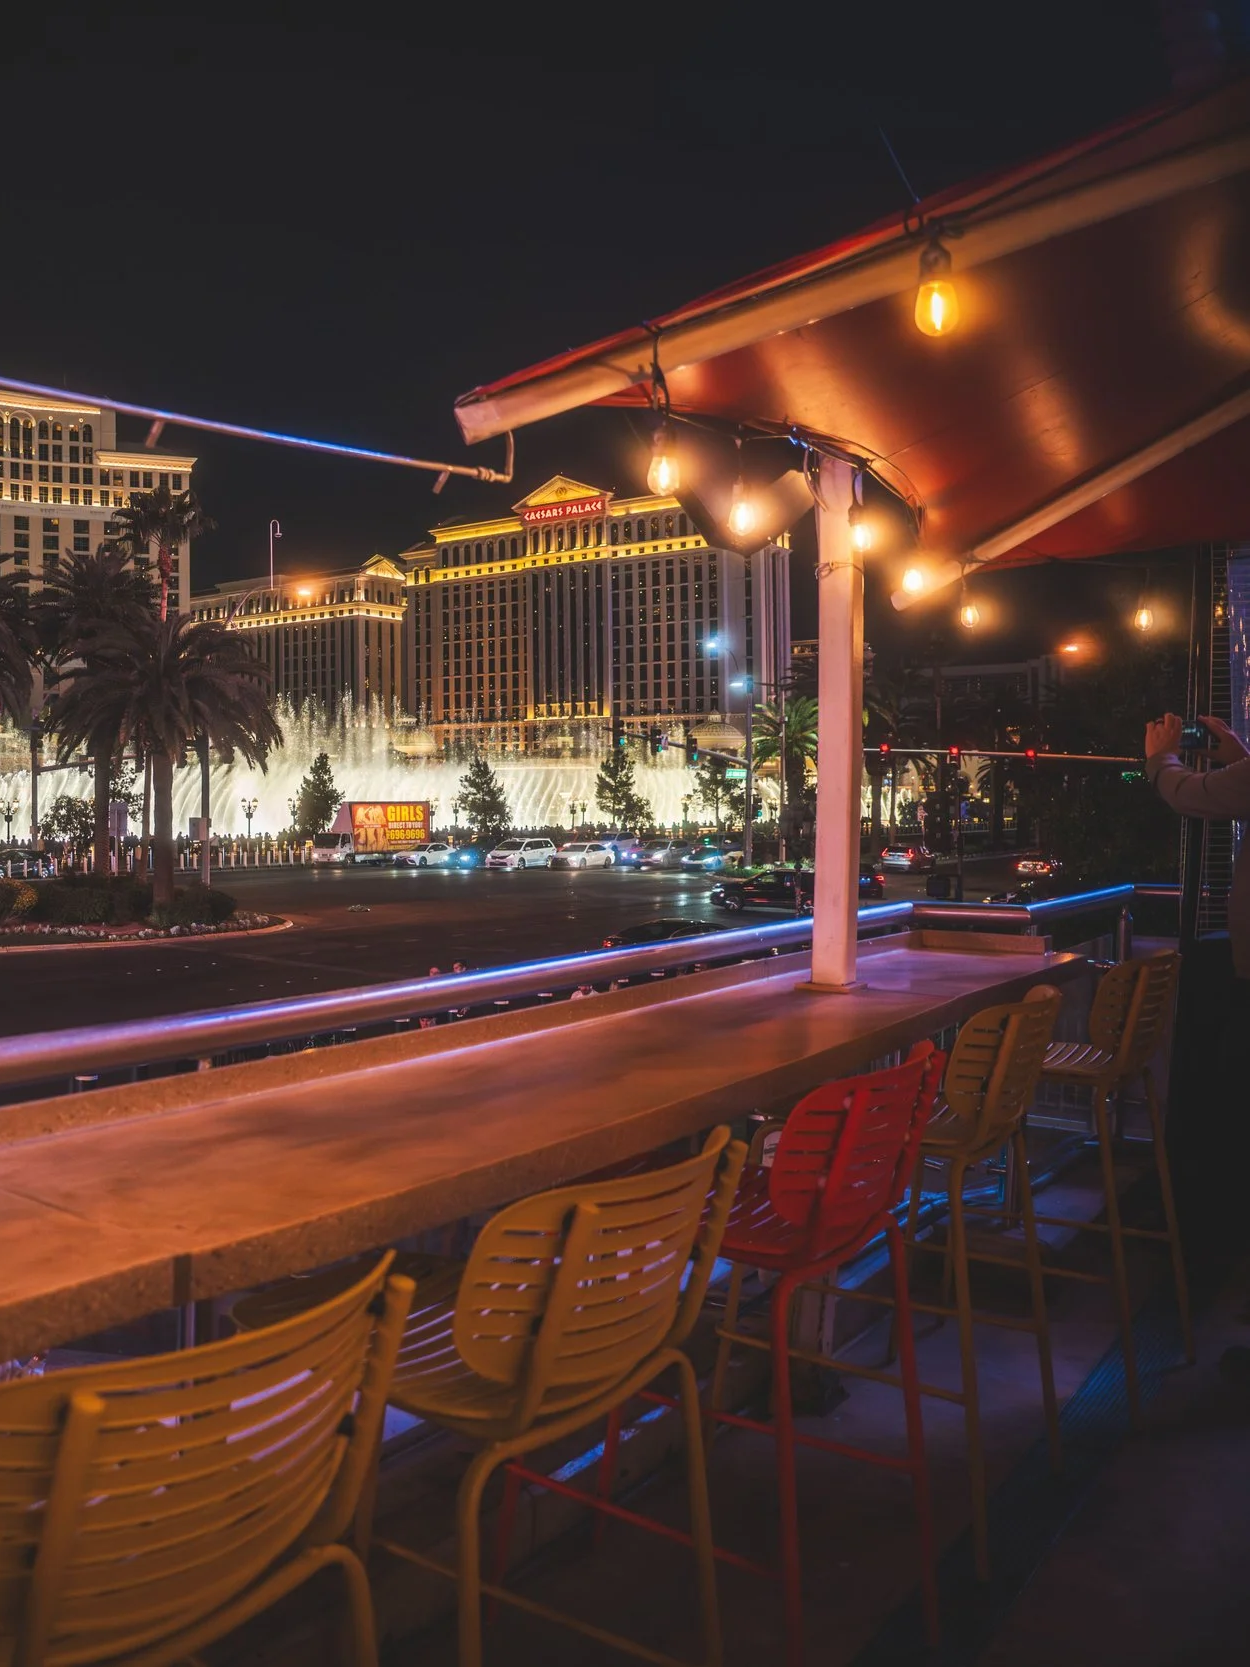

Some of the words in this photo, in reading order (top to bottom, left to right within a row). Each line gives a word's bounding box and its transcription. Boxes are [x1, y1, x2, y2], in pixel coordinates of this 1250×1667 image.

[524, 507, 563, 520] CAESARS
[566, 501, 602, 514] PALACE
[387, 805, 424, 821] GIRLS
